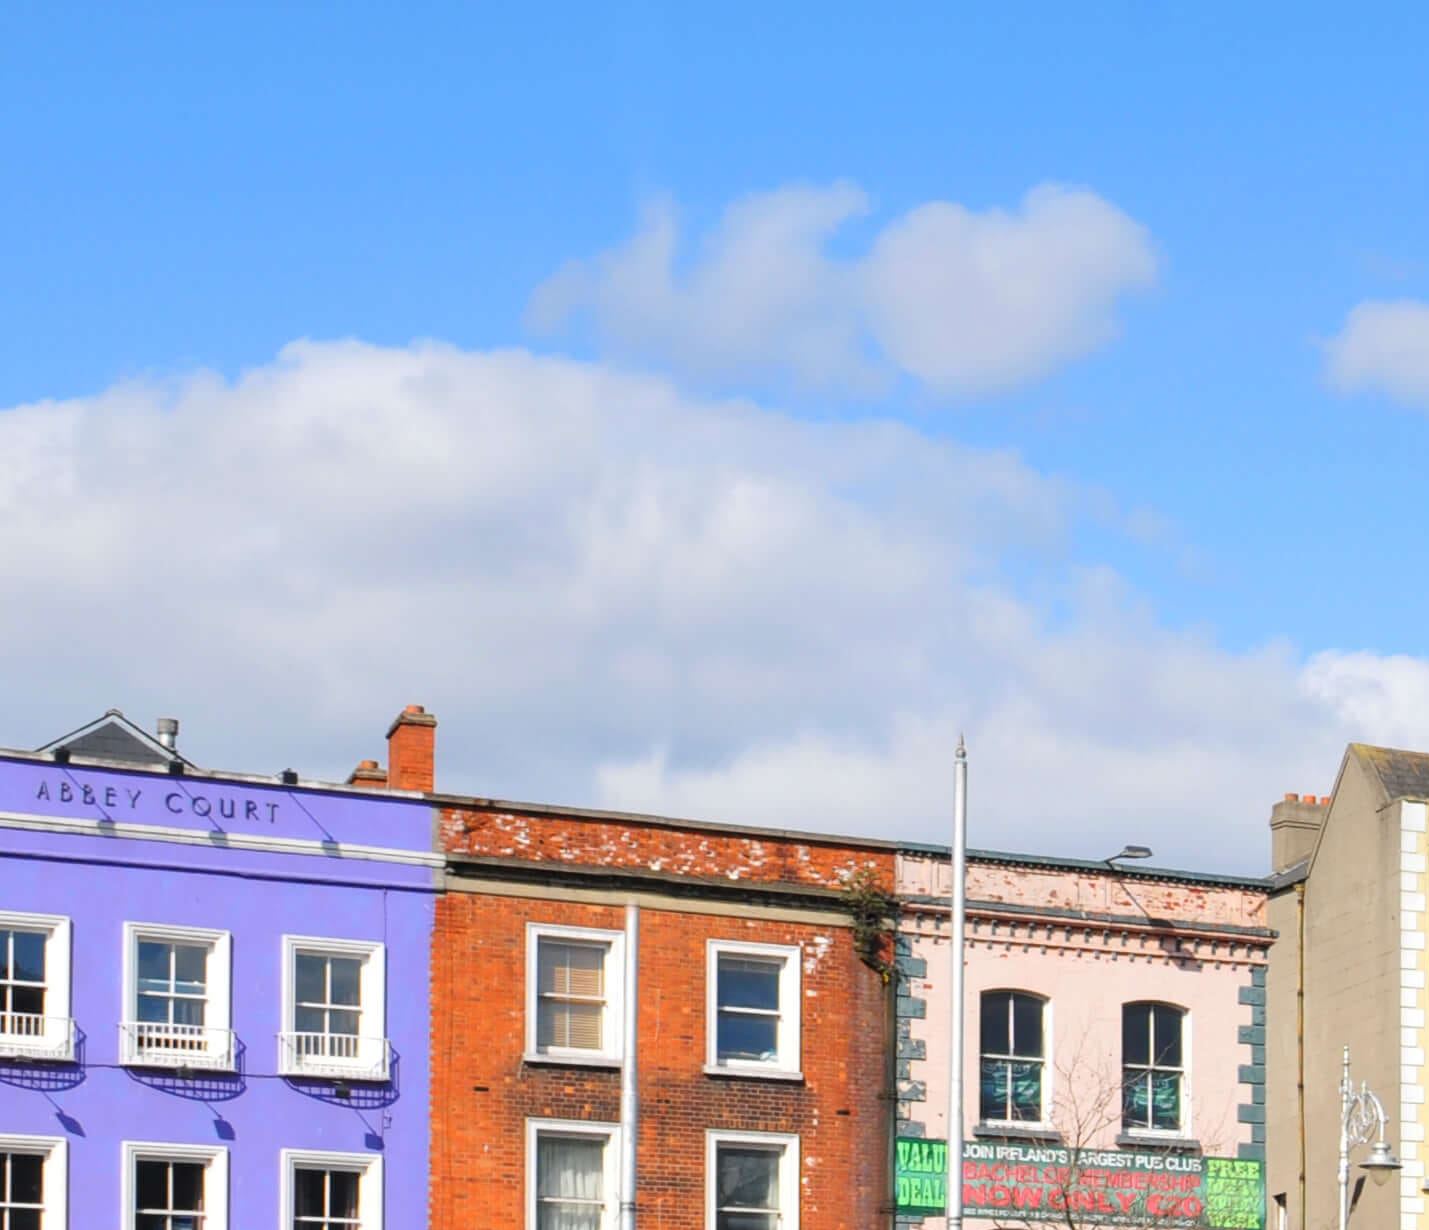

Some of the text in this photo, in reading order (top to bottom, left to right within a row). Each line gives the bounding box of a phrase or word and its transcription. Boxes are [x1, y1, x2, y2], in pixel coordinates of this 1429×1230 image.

[37, 781, 280, 824] ABBEY COURT
[897, 1141, 948, 1173] VALU
[962, 1144, 994, 1160] JOIN
[1166, 1157, 1202, 1172] CLUB
[1207, 1159, 1260, 1180] FREE
[897, 1176, 945, 1208] DEAL
[962, 1184, 1043, 1209] NOW
[1047, 1187, 1137, 1214] ONLY
